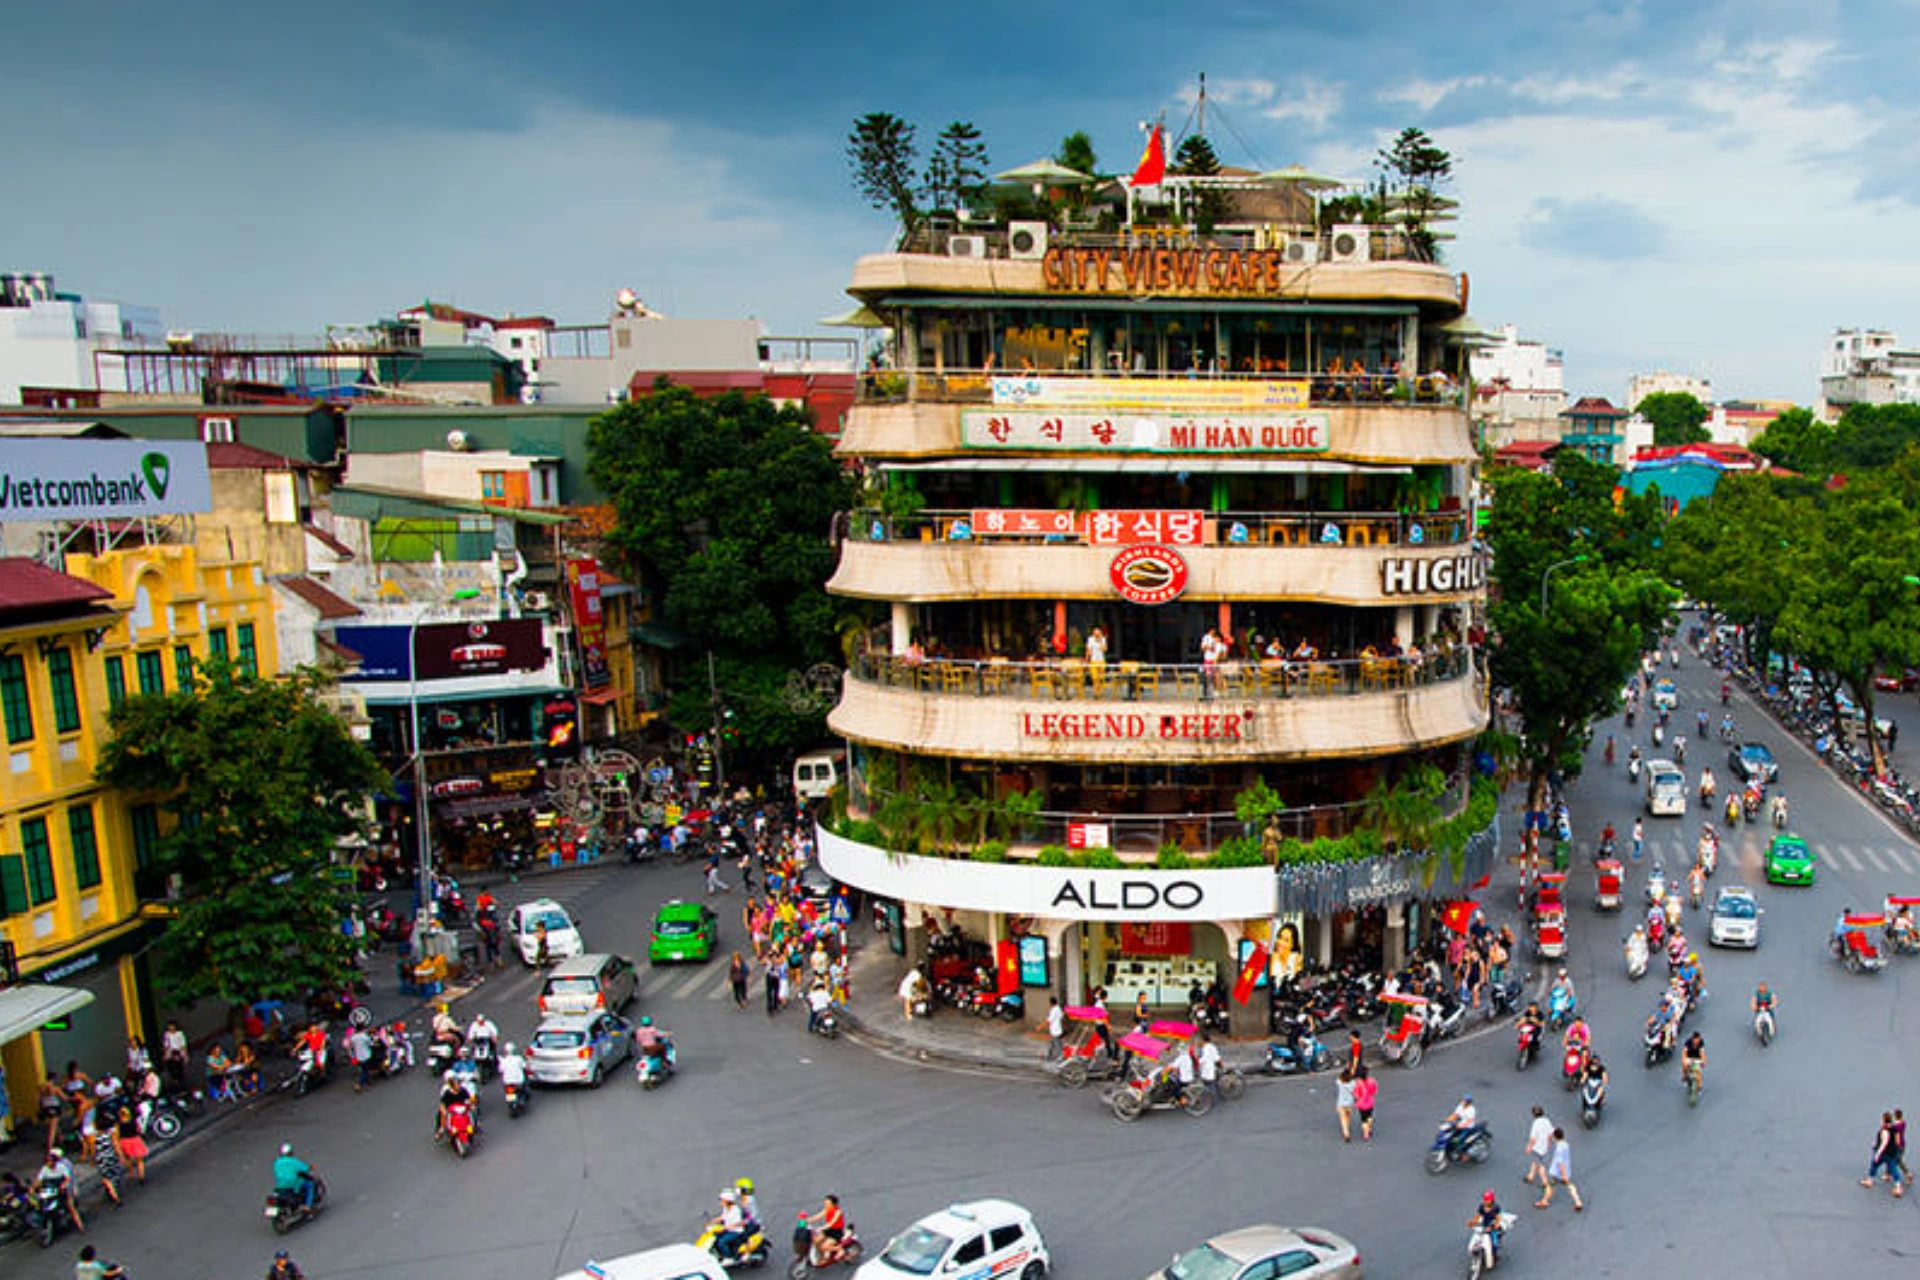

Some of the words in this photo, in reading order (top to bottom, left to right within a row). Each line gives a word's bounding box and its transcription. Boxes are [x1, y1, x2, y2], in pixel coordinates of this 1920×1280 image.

[1043, 247, 1111, 290] CITY
[1119, 248, 1200, 290] VIEW
[1204, 249, 1280, 291] CAFE
[1024, 712, 1145, 738] LEGEND
[1159, 714, 1242, 738] BEER
[1051, 879, 1204, 910] ALDO
